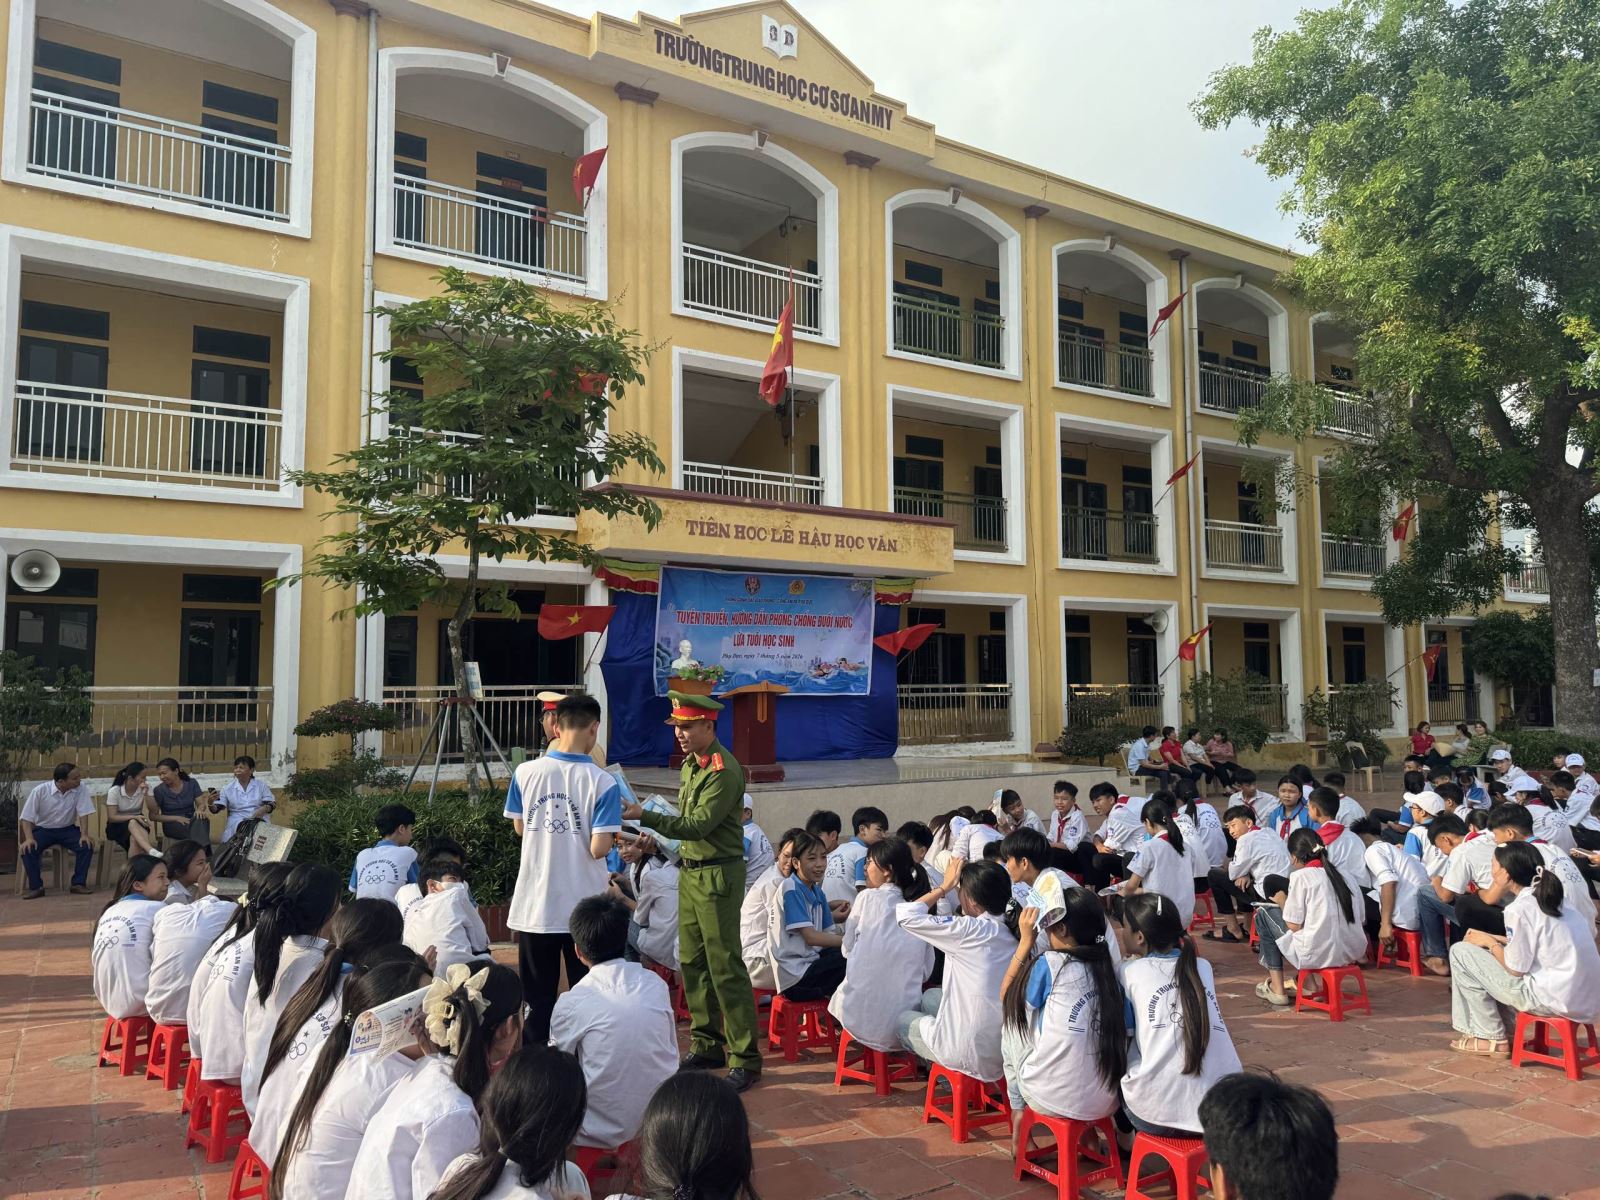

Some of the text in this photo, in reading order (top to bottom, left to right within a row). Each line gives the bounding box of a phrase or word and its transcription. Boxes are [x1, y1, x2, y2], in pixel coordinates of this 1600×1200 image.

[777, 71, 808, 101] HỌC
[850, 97, 871, 124] AN
[799, 526, 831, 549] HẬU
[835, 533, 865, 552] HỌC
[762, 634, 776, 649] HỌC
[778, 634, 795, 648] SINH
[1083, 990, 1097, 1001] TRU
